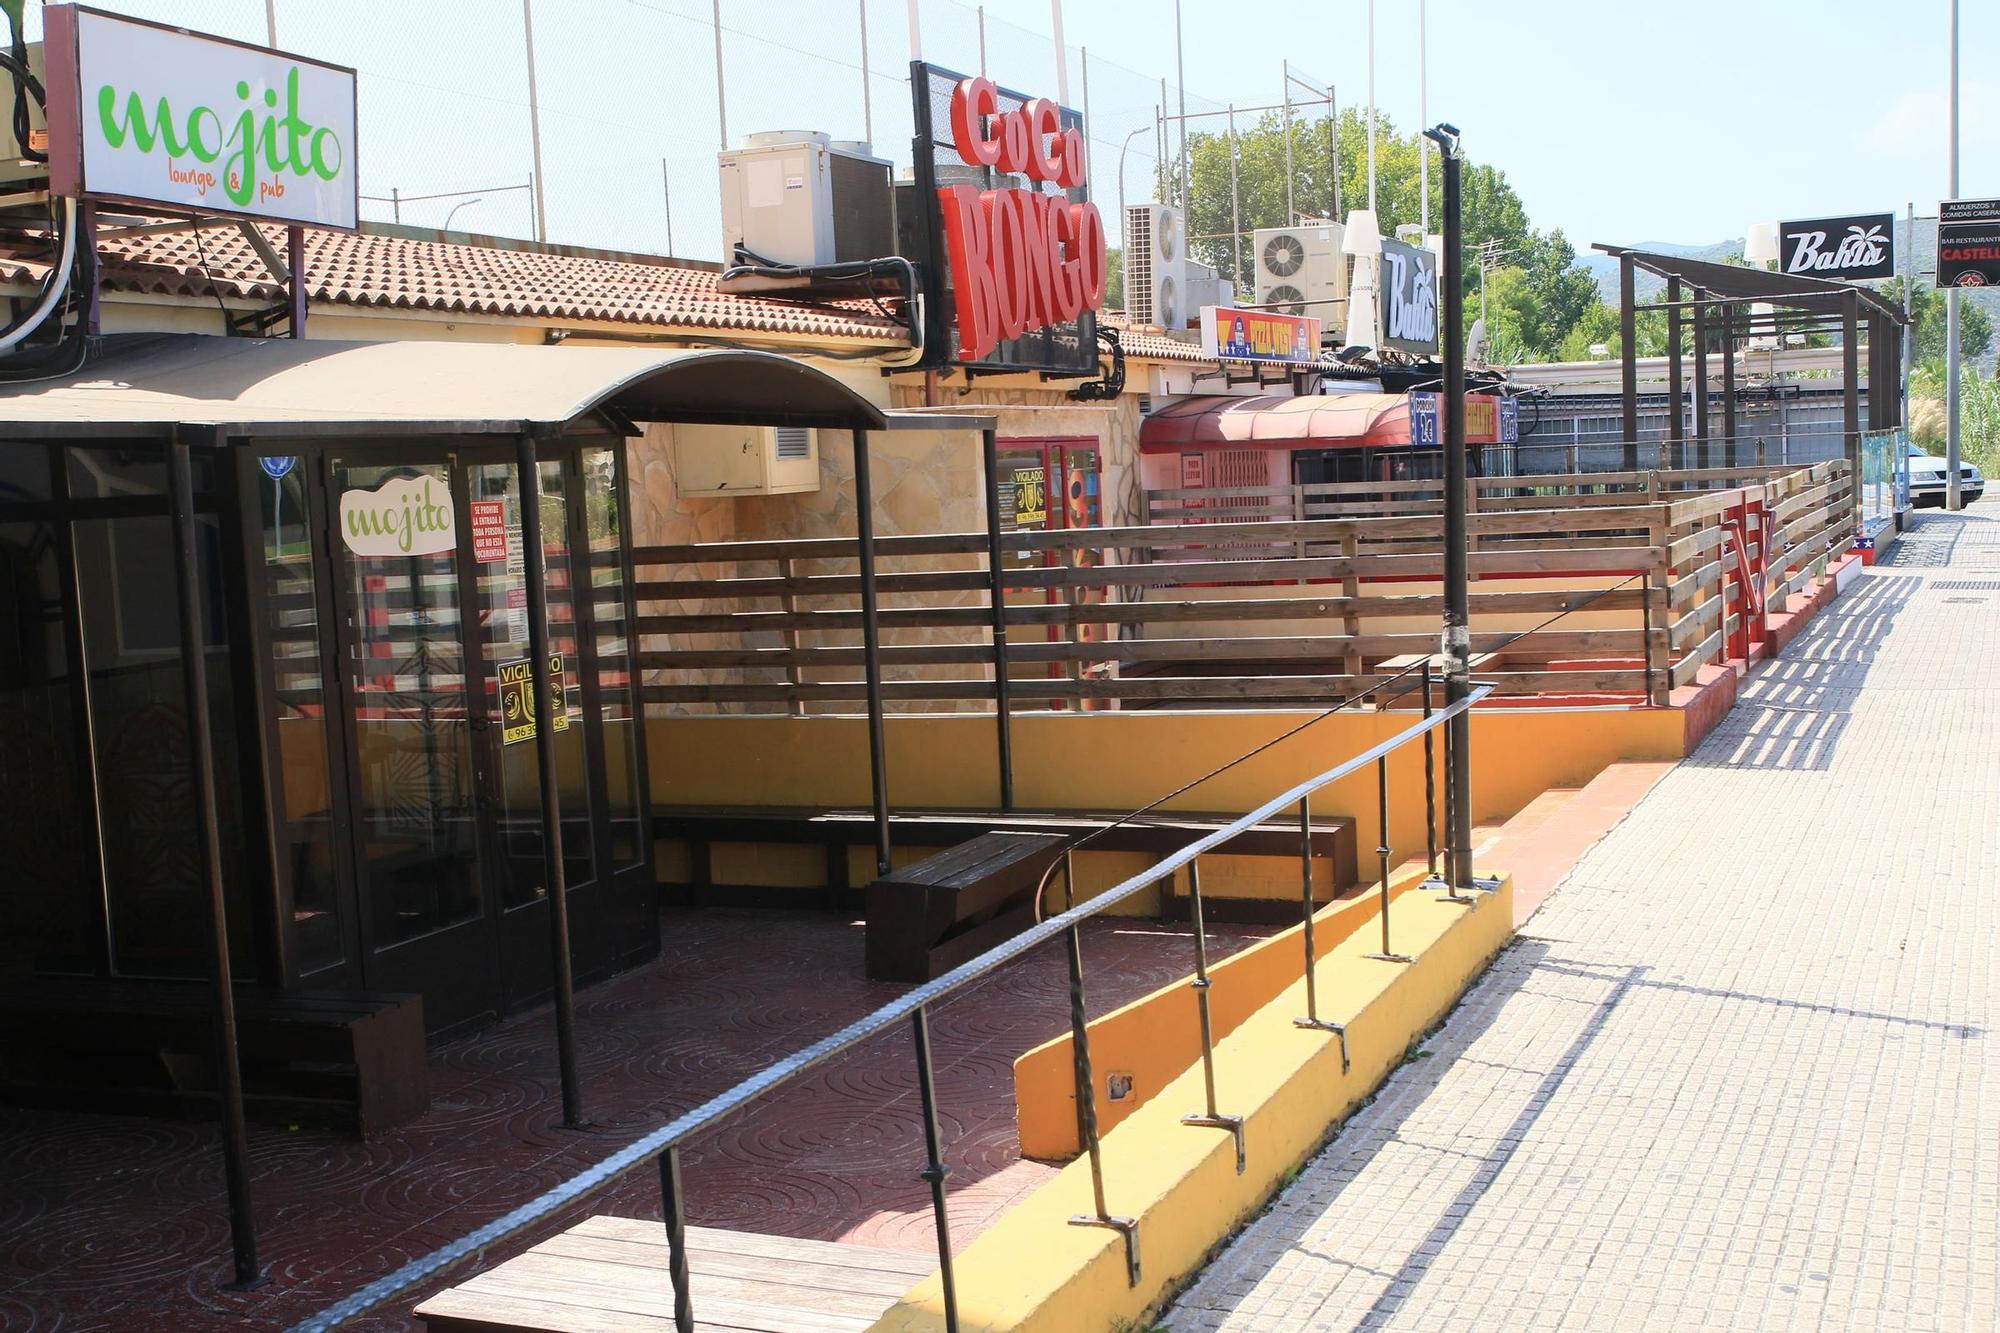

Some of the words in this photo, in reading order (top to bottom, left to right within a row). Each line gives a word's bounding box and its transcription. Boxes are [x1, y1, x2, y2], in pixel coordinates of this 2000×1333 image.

[98, 66, 342, 207] mojito
[168, 157, 216, 195] lounge
[230, 172, 240, 190] &
[260, 174, 285, 203] pub
[1941, 211, 1972, 219] COMIDAS
[1949, 203, 1990, 211] ALMUERZOS
[936, 184, 1107, 361] BONGO
[1015, 471, 1044, 483] VIGILADO
[347, 480, 450, 553] mojito
[476, 548, 505, 558] OCUMENTADA
[501, 658, 560, 682] VIGILO
